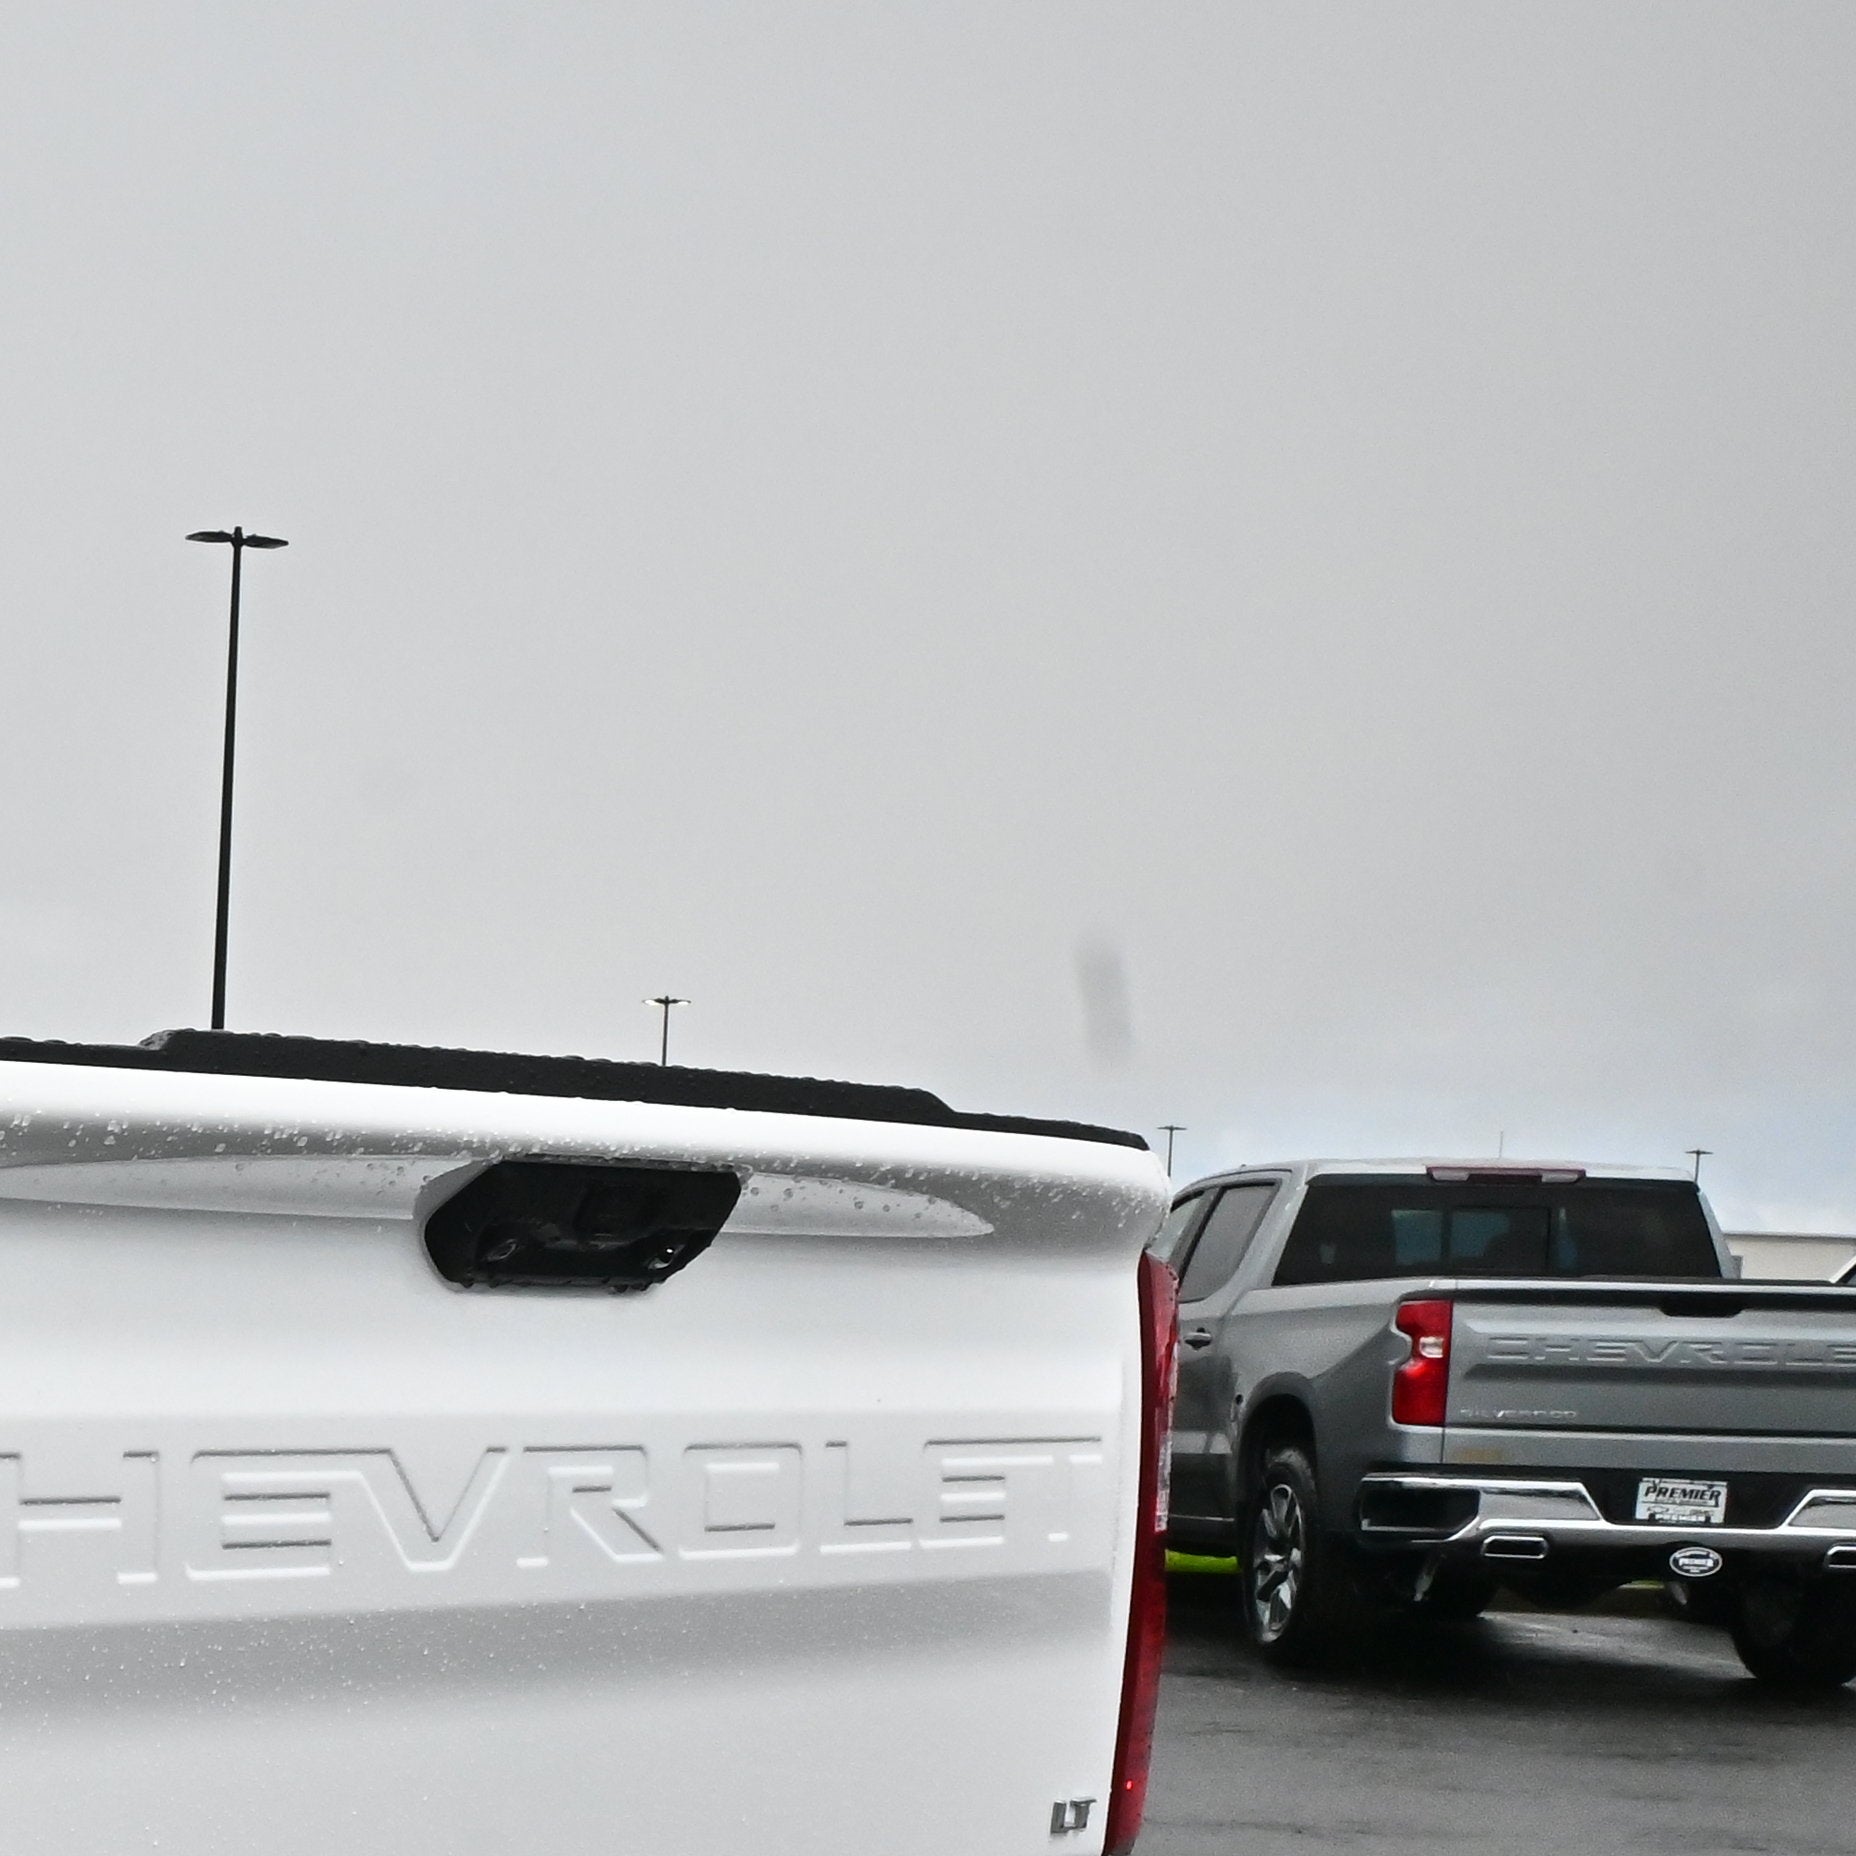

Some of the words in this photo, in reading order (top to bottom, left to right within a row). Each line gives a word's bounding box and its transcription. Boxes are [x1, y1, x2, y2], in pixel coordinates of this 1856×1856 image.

[1487, 1336, 1856, 1367] CHEVROLE
[1644, 1486, 1722, 1502] PREMIER
[1050, 1798, 1097, 1834] LT
